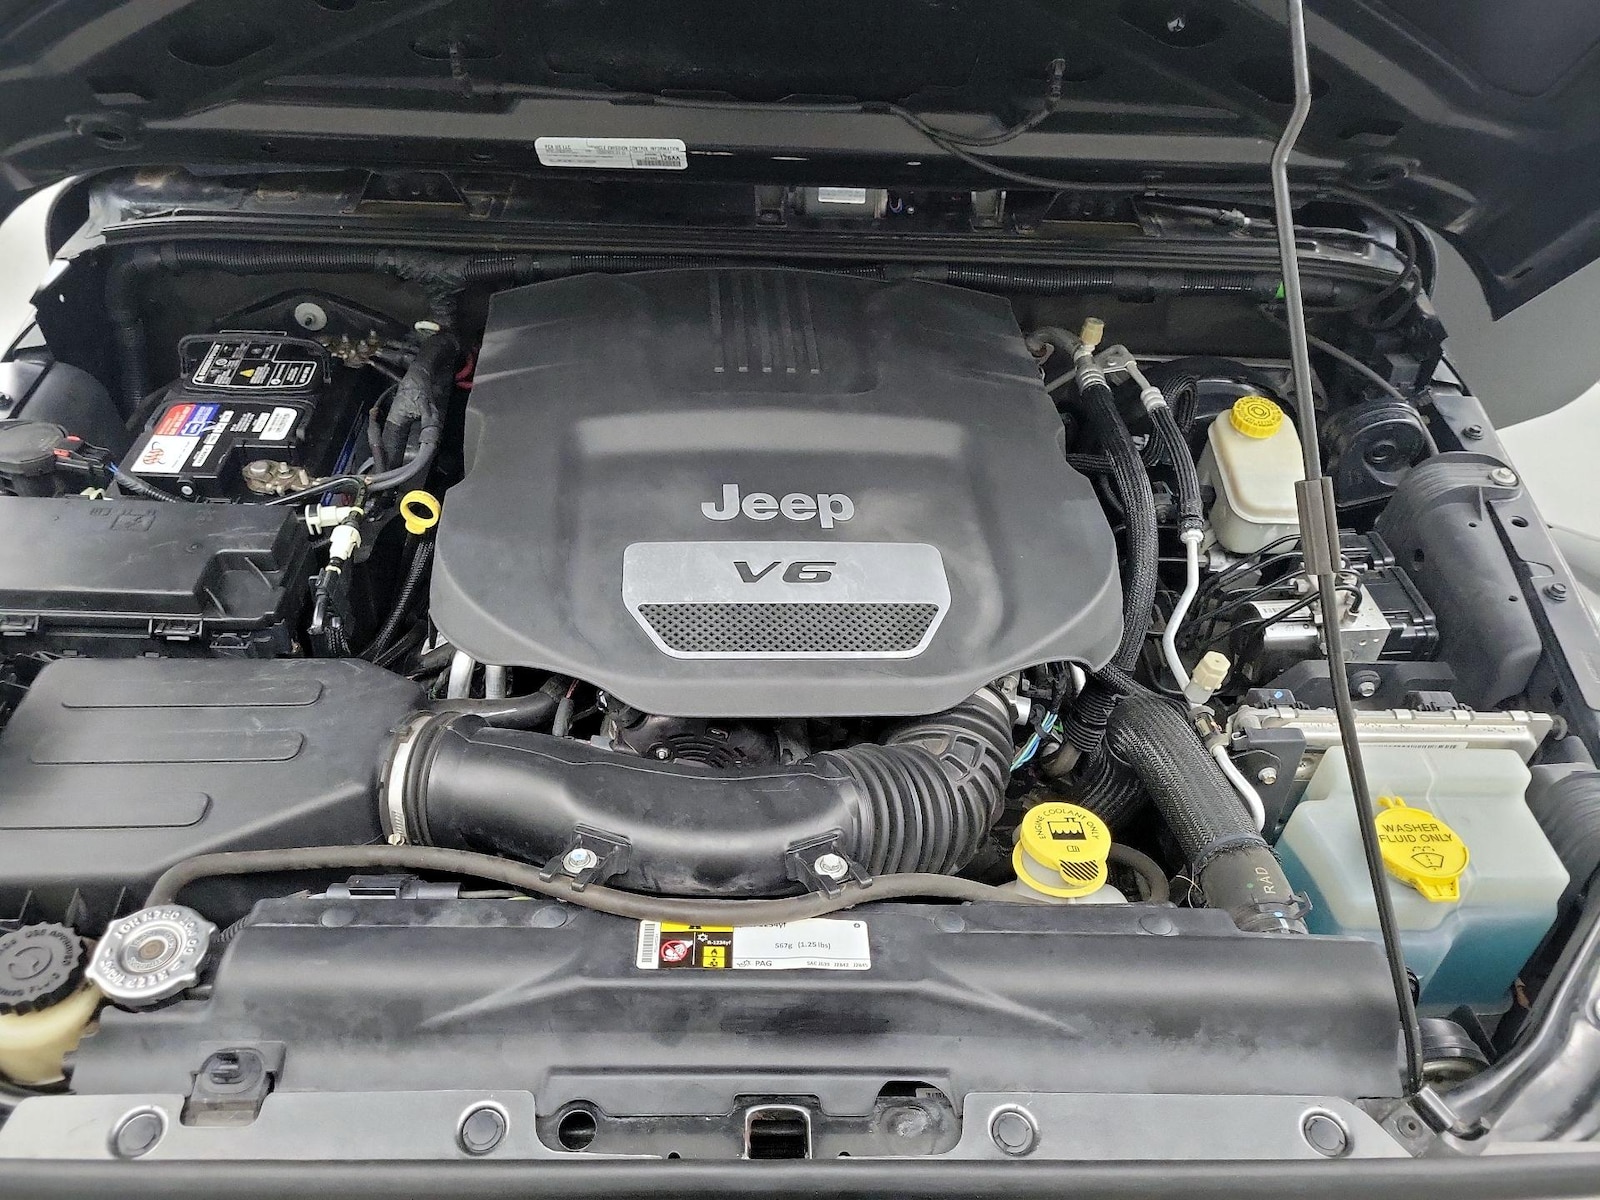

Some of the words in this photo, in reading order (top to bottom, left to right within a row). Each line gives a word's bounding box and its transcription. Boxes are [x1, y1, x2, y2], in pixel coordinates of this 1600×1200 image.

[701, 483, 855, 528] Jeep
[733, 561, 837, 584] V6
[1034, 816, 1046, 840] ENGINE
[1043, 808, 1086, 820] COOLANT
[1086, 821, 1100, 840] ONLY
[1382, 824, 1440, 832] WASHER
[1378, 834, 1416, 843] FLUID
[1420, 834, 1453, 842] ONLY
[1255, 866, 1276, 894] RAD
